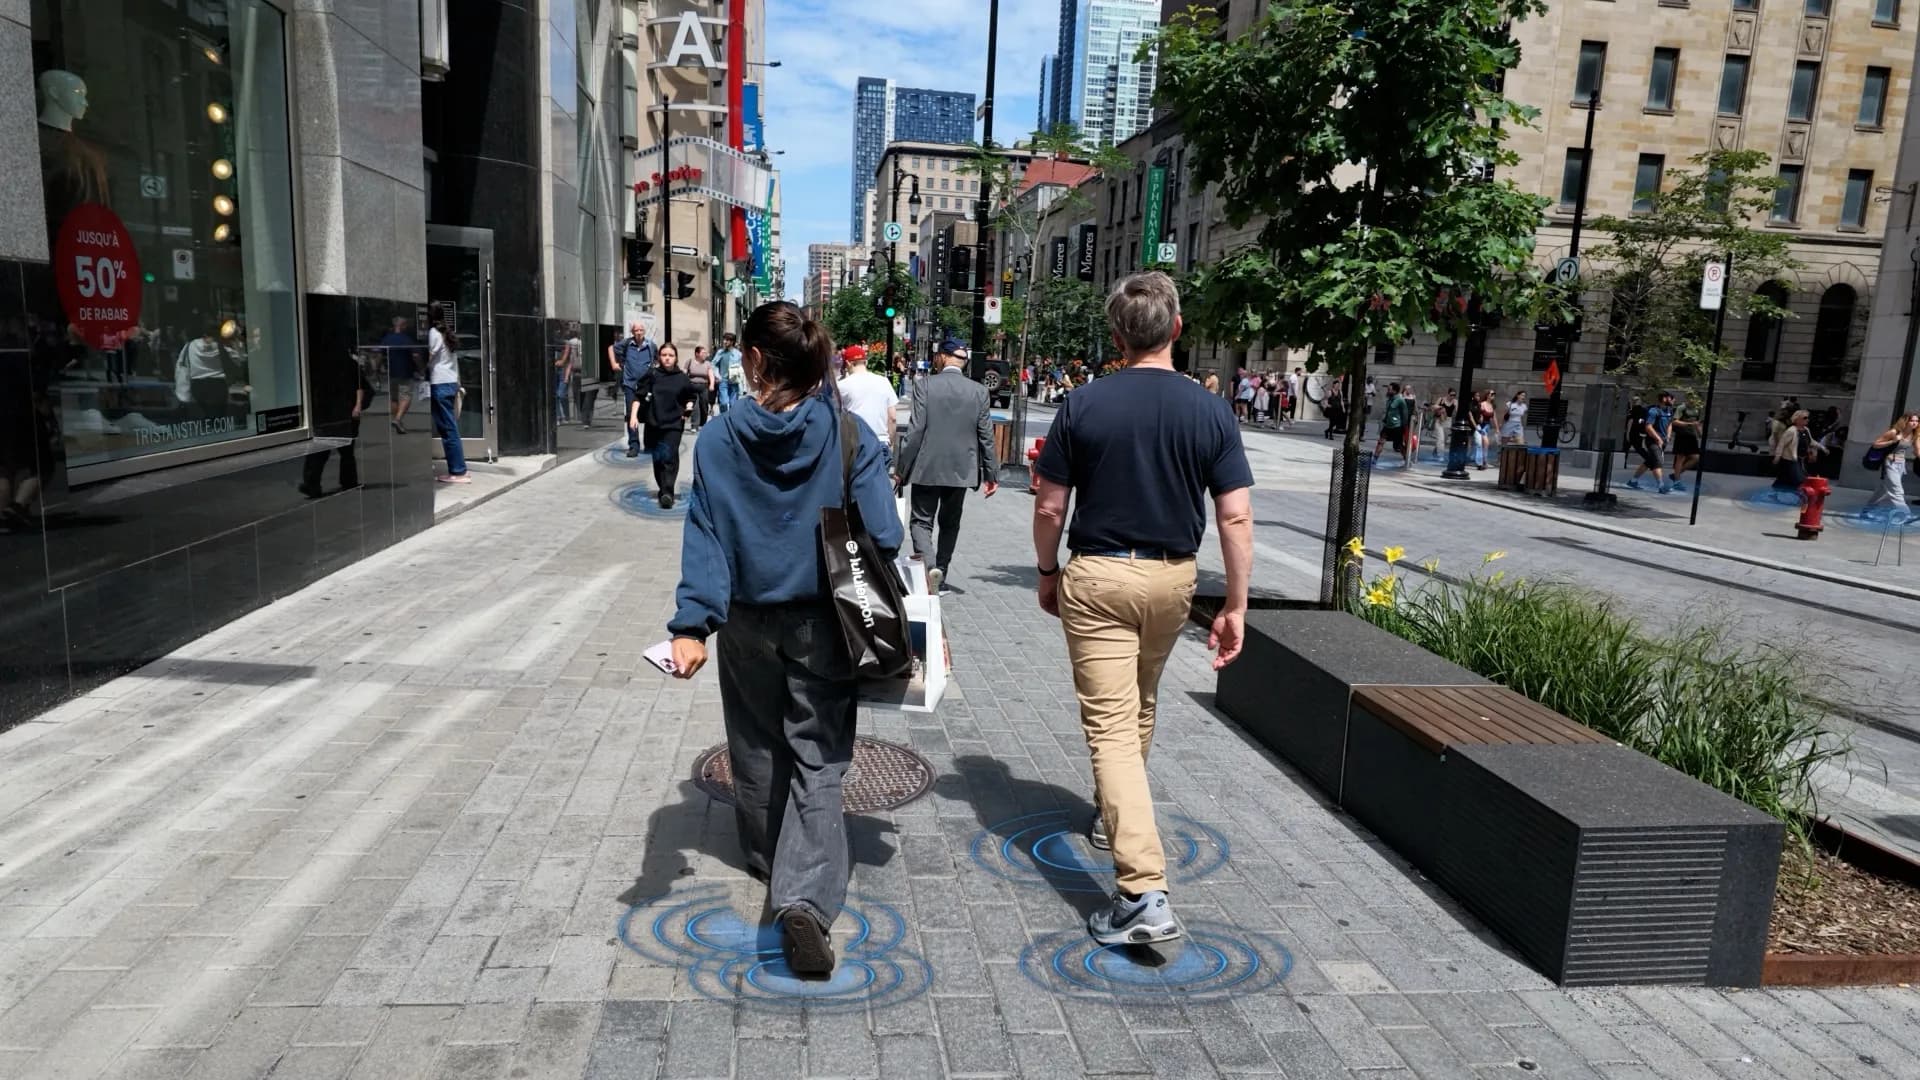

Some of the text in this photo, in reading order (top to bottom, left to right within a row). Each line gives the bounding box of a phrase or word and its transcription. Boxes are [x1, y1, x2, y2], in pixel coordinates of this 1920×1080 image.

[666, 11, 716, 68] A
[651, 164, 703, 187] Sotia
[76, 230, 120, 248] JUSQU'À
[1147, 183, 1160, 263] PHARMACIE
[1052, 243, 1065, 281] Moores
[1081, 232, 1094, 274] Moores
[75, 255, 127, 298] 50%
[79, 307, 129, 321] DE RABAIS
[133, 416, 235, 447] TRISTANSTYLE.COM
[849, 557, 875, 629] lululemon
